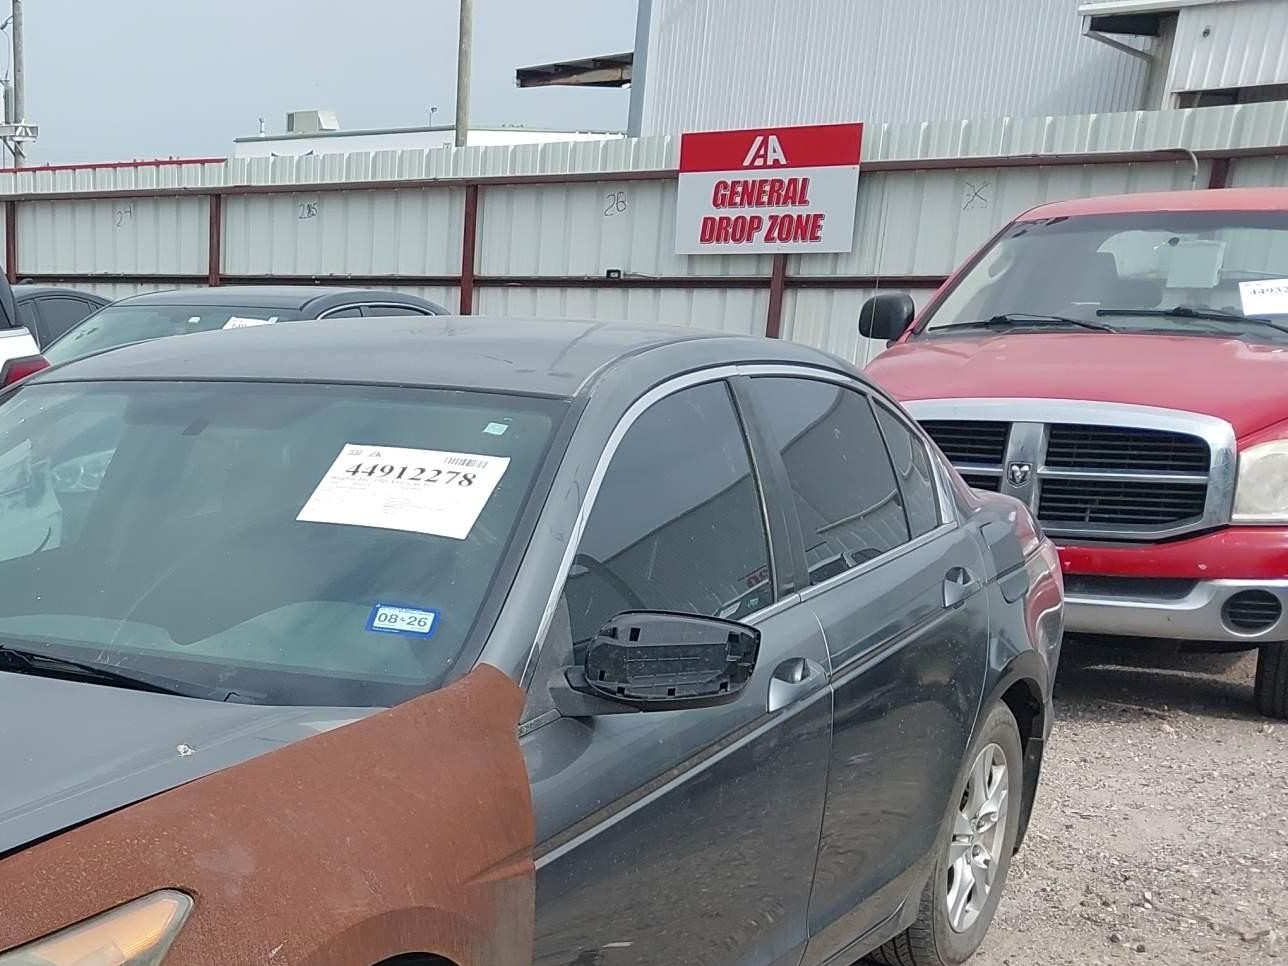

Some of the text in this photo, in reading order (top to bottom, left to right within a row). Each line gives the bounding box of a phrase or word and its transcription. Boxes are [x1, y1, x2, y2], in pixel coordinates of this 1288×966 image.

[712, 177, 811, 209] GENERAL
[699, 213, 826, 245] DROP ZONE
[345, 462, 477, 487] 44912278
